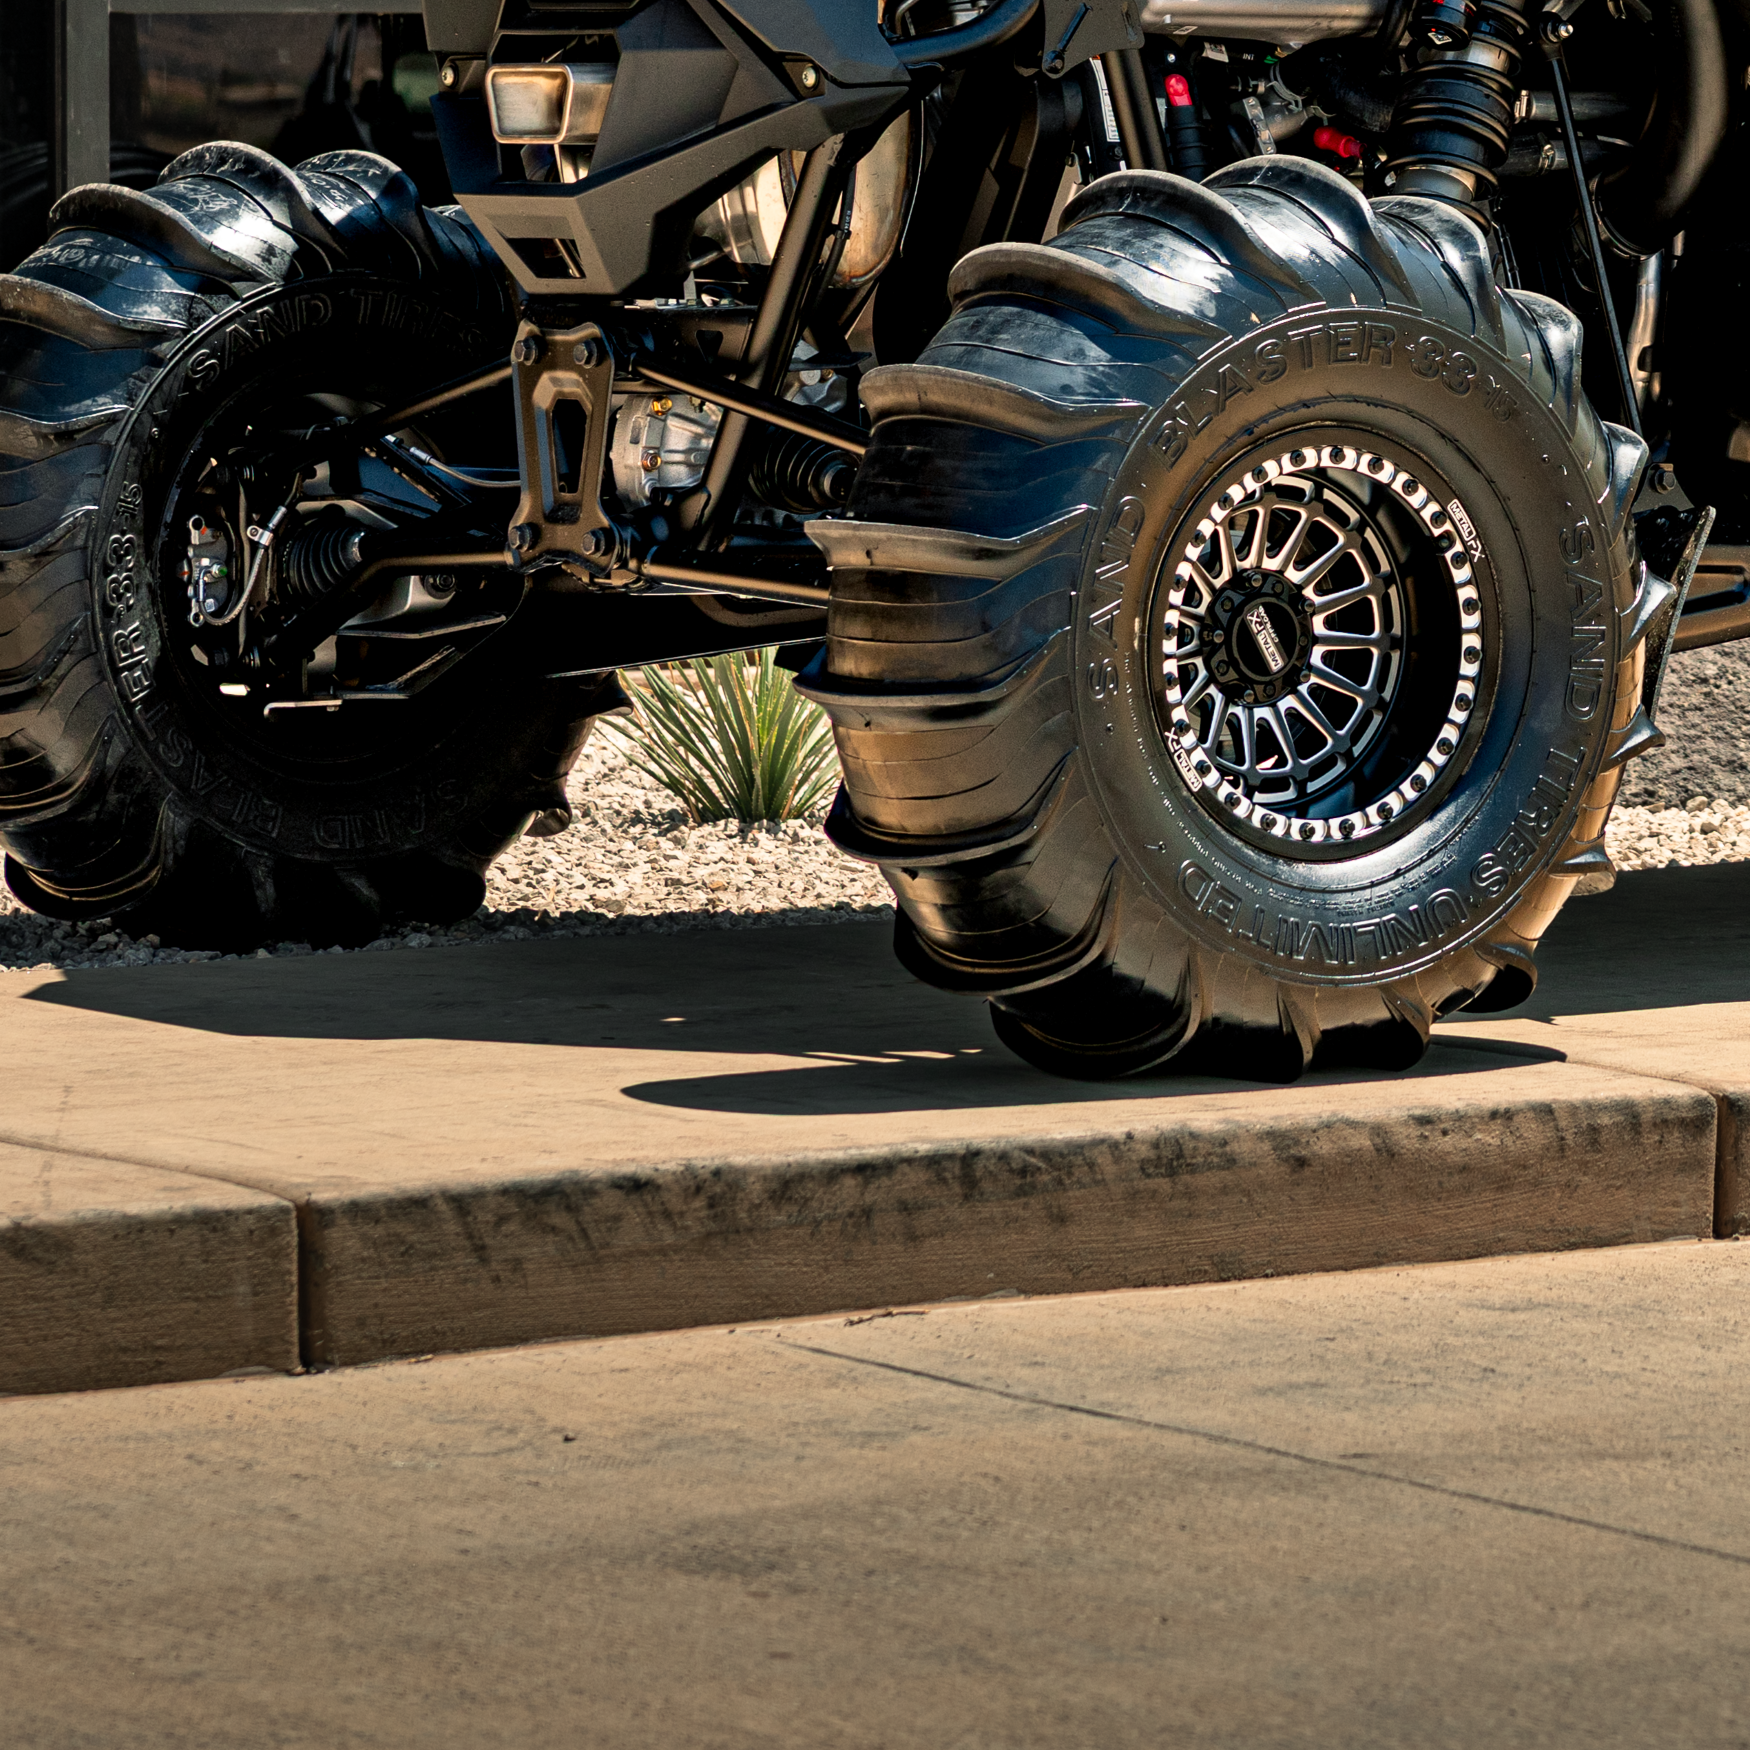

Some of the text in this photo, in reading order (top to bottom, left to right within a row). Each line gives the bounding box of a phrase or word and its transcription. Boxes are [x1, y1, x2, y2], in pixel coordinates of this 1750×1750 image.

[1089, 496, 1145, 700] SAND
[1150, 321, 1398, 471] BLASTER
[1449, 502, 1474, 538] METAL
[1257, 630, 1283, 669] METAL
[1560, 514, 1606, 721] SAND
[1471, 746, 1588, 898] TIRES
[1178, 858, 1470, 966] UNLIMITED
